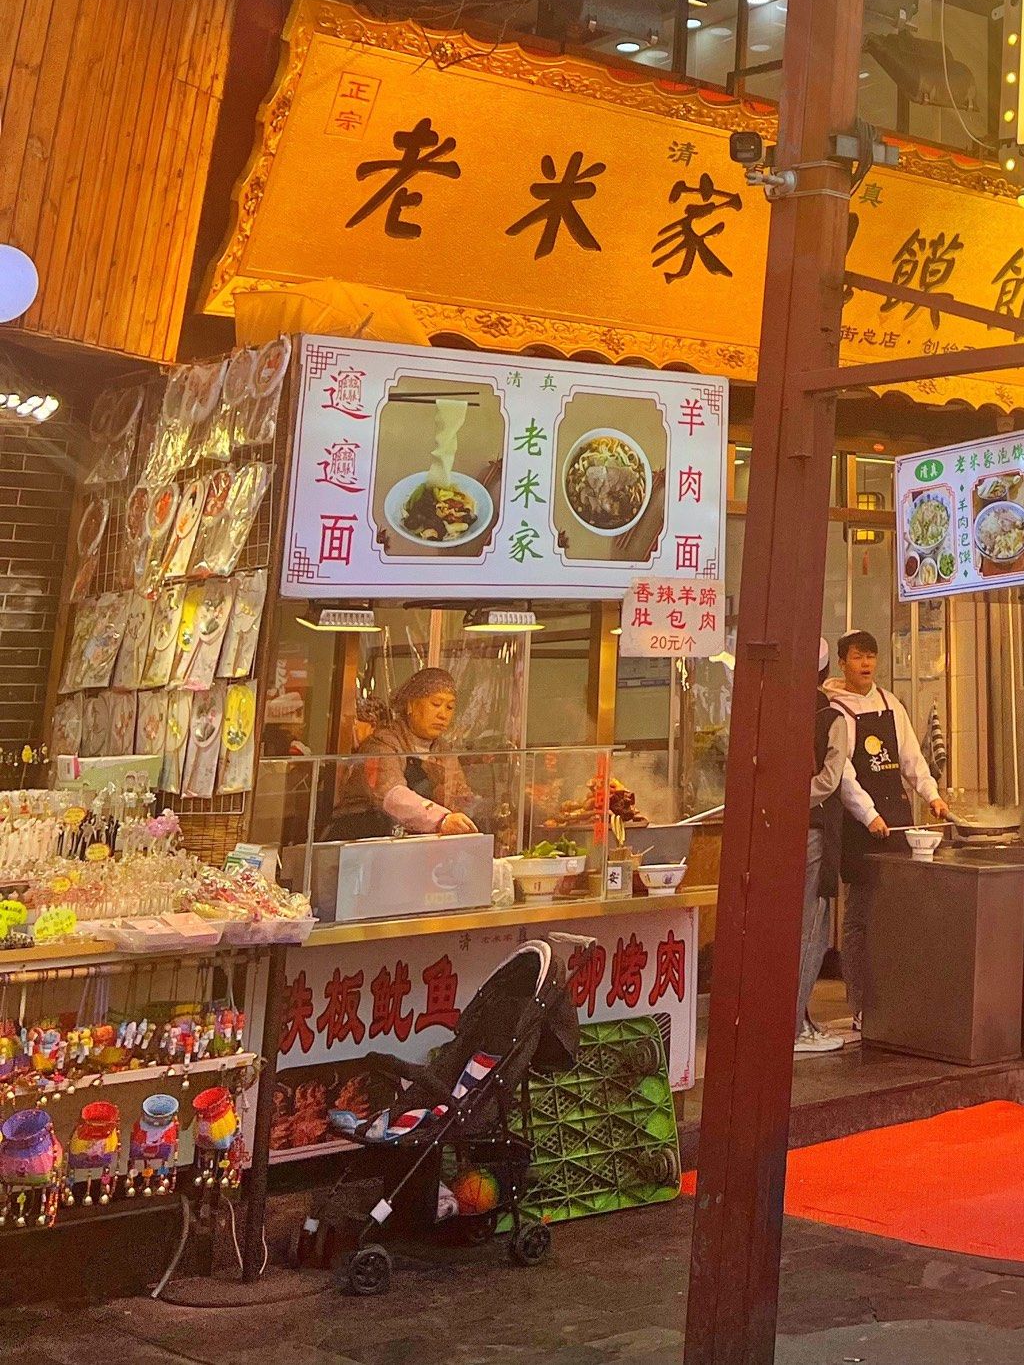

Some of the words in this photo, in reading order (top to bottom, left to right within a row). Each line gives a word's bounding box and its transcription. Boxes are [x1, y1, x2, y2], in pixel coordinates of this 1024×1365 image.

[336, 80, 371, 131] 正宗
[506, 370, 558, 392] 清真
[674, 397, 706, 572] 羊肉面
[918, 463, 940, 480] 清真
[508, 418, 548, 564] 老米家
[956, 498, 973, 567] 羊肉泡馍
[633, 582, 717, 608] 香辣羊蹄
[631, 607, 716, 632] 肚包肉
[650, 635, 697, 652] 20元/个
